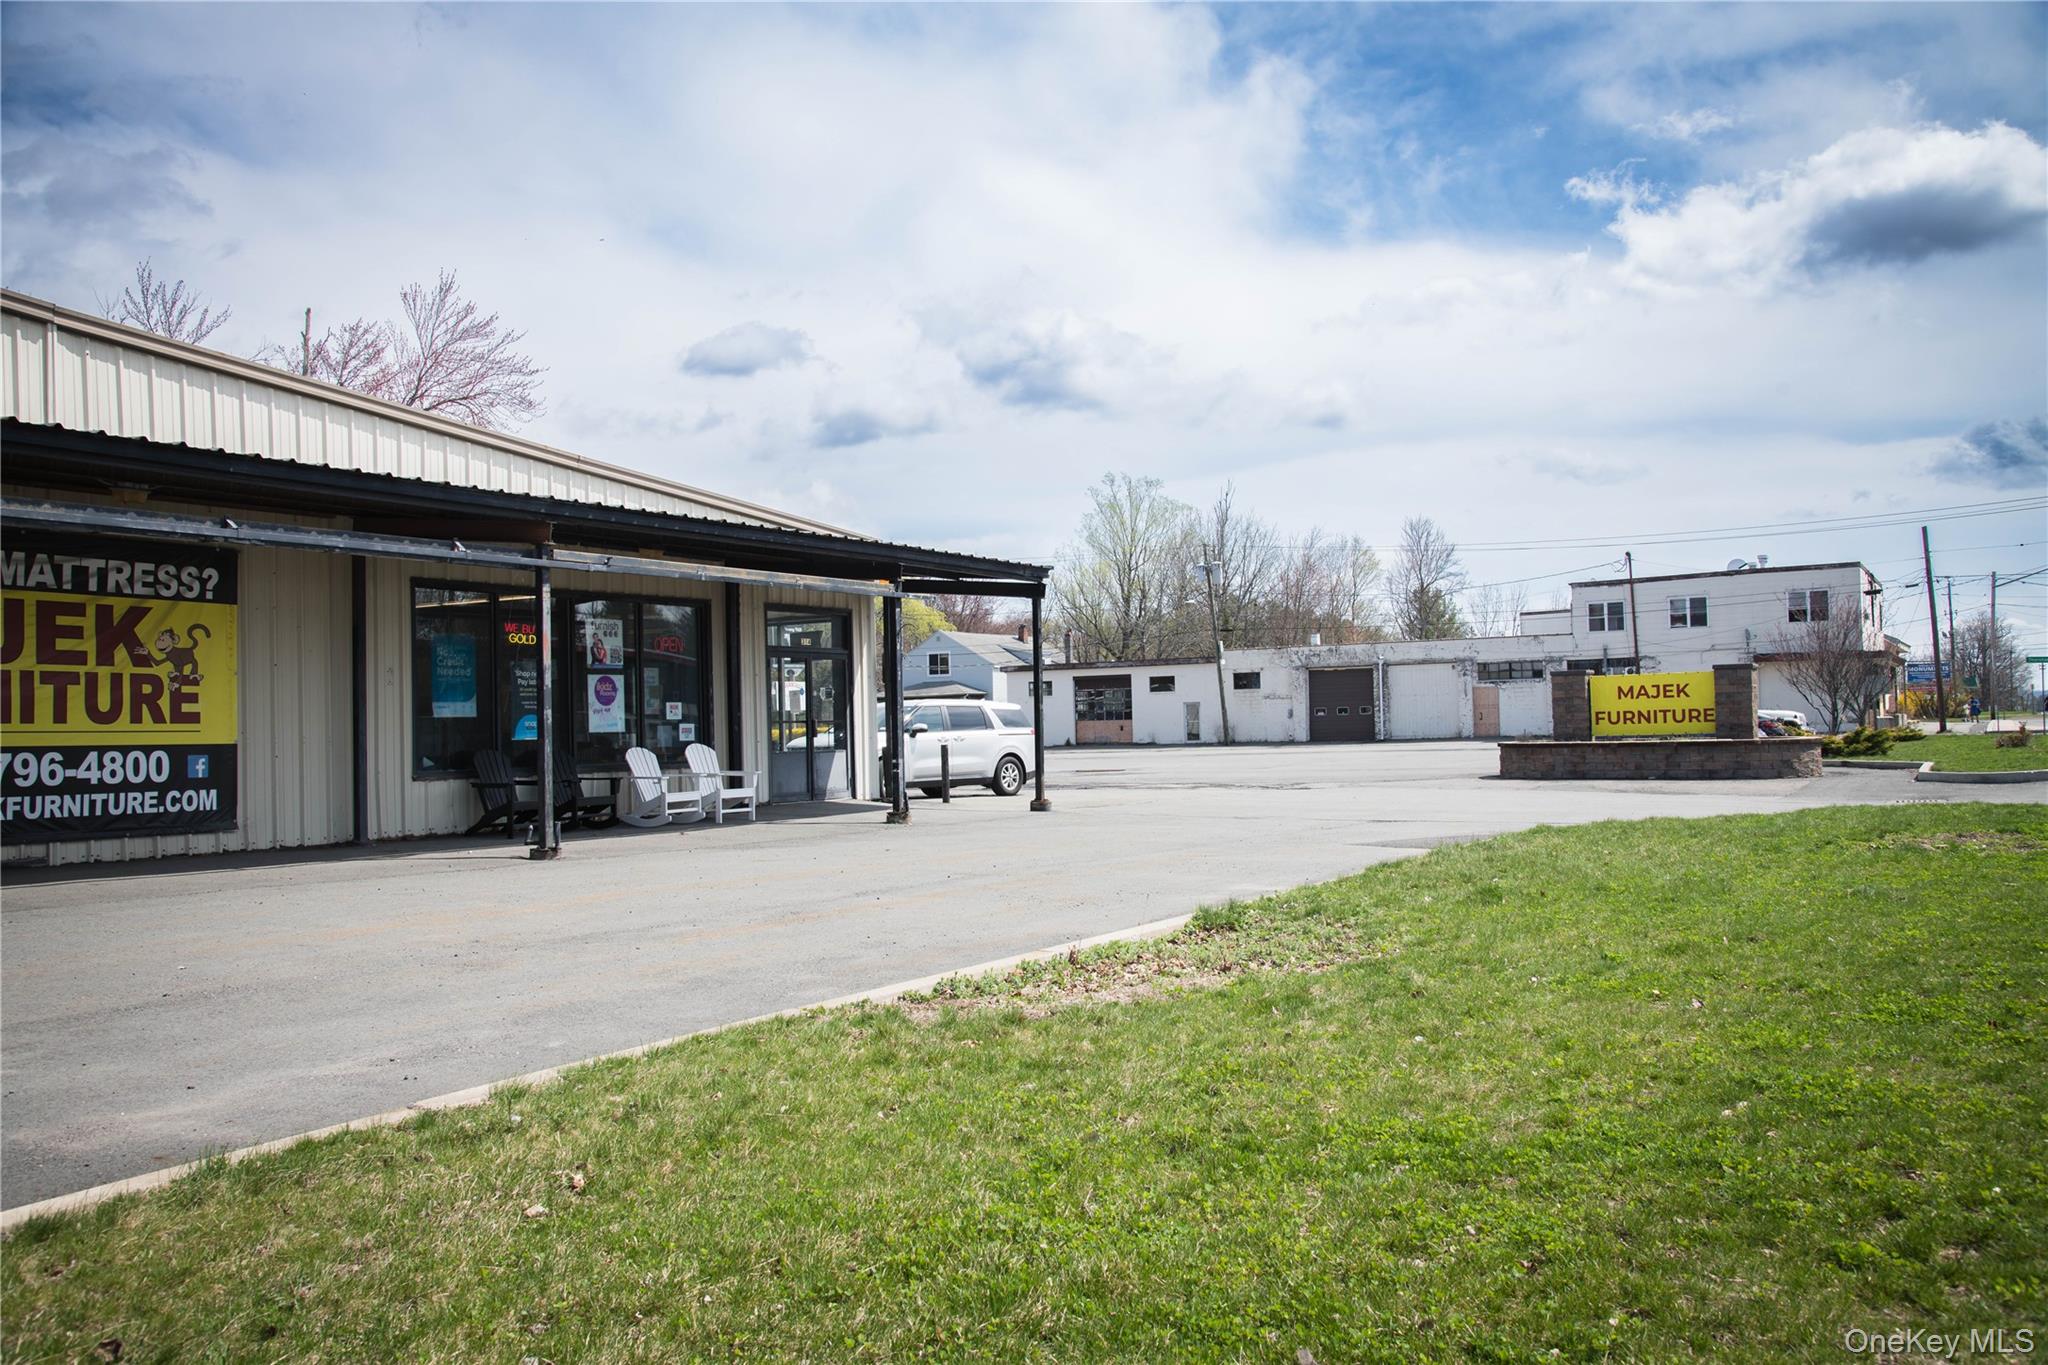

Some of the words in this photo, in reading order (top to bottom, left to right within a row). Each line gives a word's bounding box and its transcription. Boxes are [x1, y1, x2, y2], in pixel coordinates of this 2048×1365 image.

[0, 550, 220, 600] MATTRESS?
[504, 623, 518, 634] WE
[521, 624, 537, 635] BU
[508, 633, 537, 645] GOLD
[655, 637, 684, 652] OPEN
[514, 669, 530, 678] Shop
[518, 679, 528, 687] Pay
[1617, 683, 1690, 700] MAJEK
[1595, 708, 1716, 725] FURNITURE
